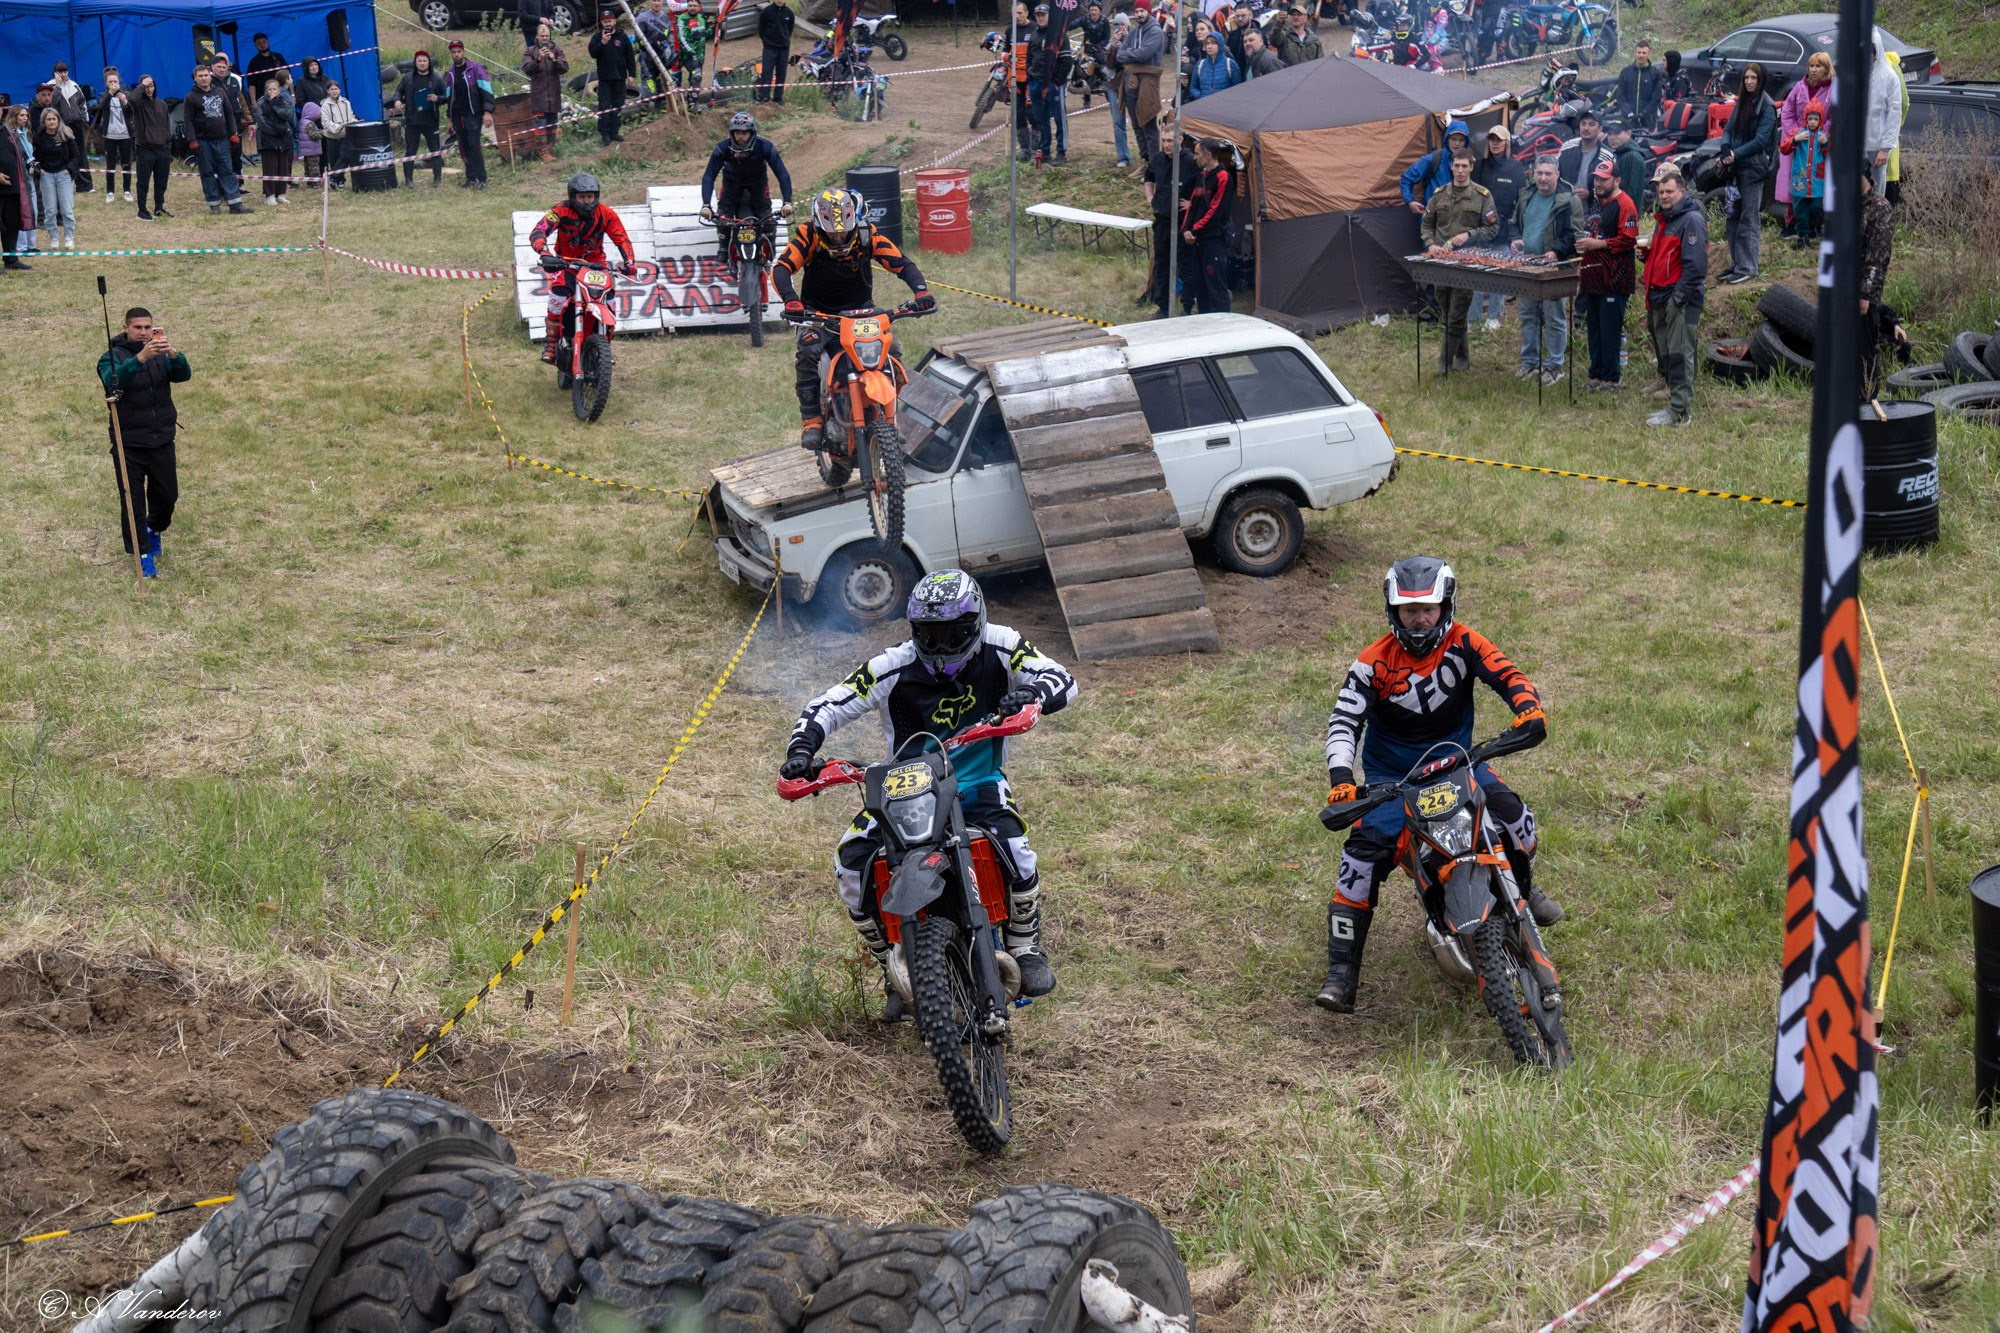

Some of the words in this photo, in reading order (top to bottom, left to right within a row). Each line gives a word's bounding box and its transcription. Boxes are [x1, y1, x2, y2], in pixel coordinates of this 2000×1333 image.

[360, 151, 394, 161] RECOR
[863, 325, 870, 333] 8
[896, 774, 917, 789] 23
[1428, 794, 1447, 808] 24
[1338, 857, 1365, 891] OX
[1331, 915, 1355, 941] G
